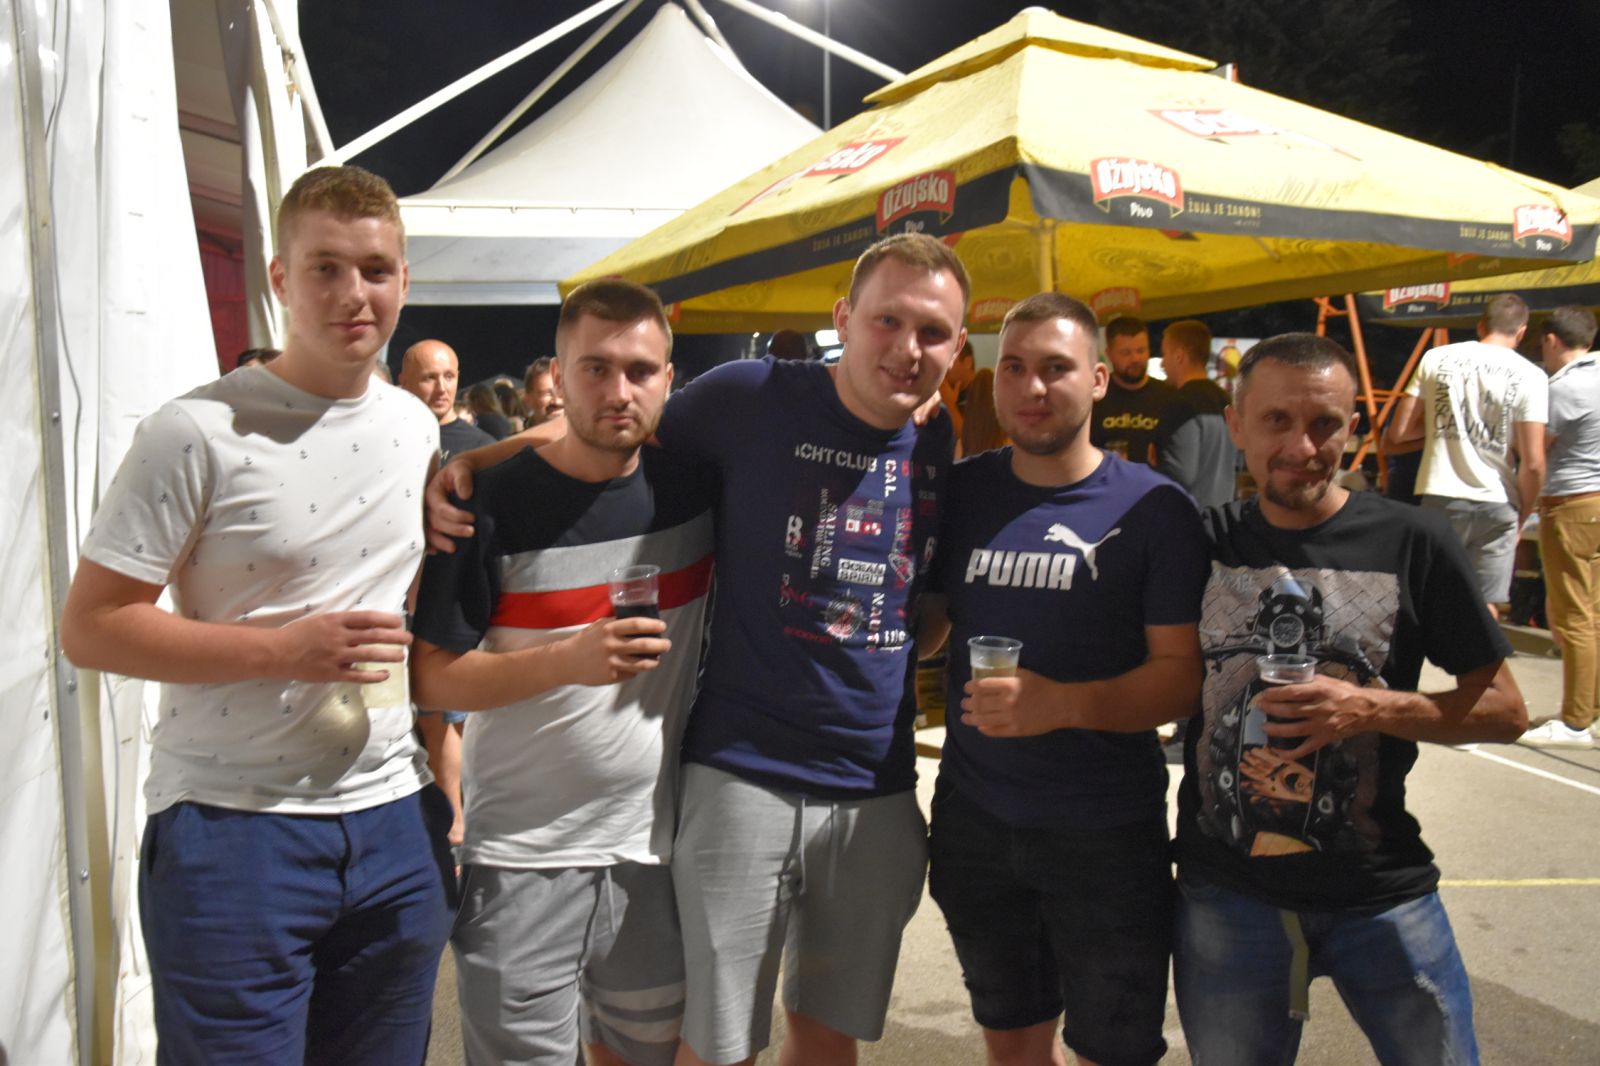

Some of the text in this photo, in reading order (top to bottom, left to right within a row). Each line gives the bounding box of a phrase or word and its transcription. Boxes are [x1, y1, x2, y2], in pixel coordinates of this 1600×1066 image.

[1129, 202, 1153, 218] Pivo
[1213, 204, 1225, 215] JE
[836, 451, 878, 472] CLUB
[965, 548, 1077, 591] PUMA
